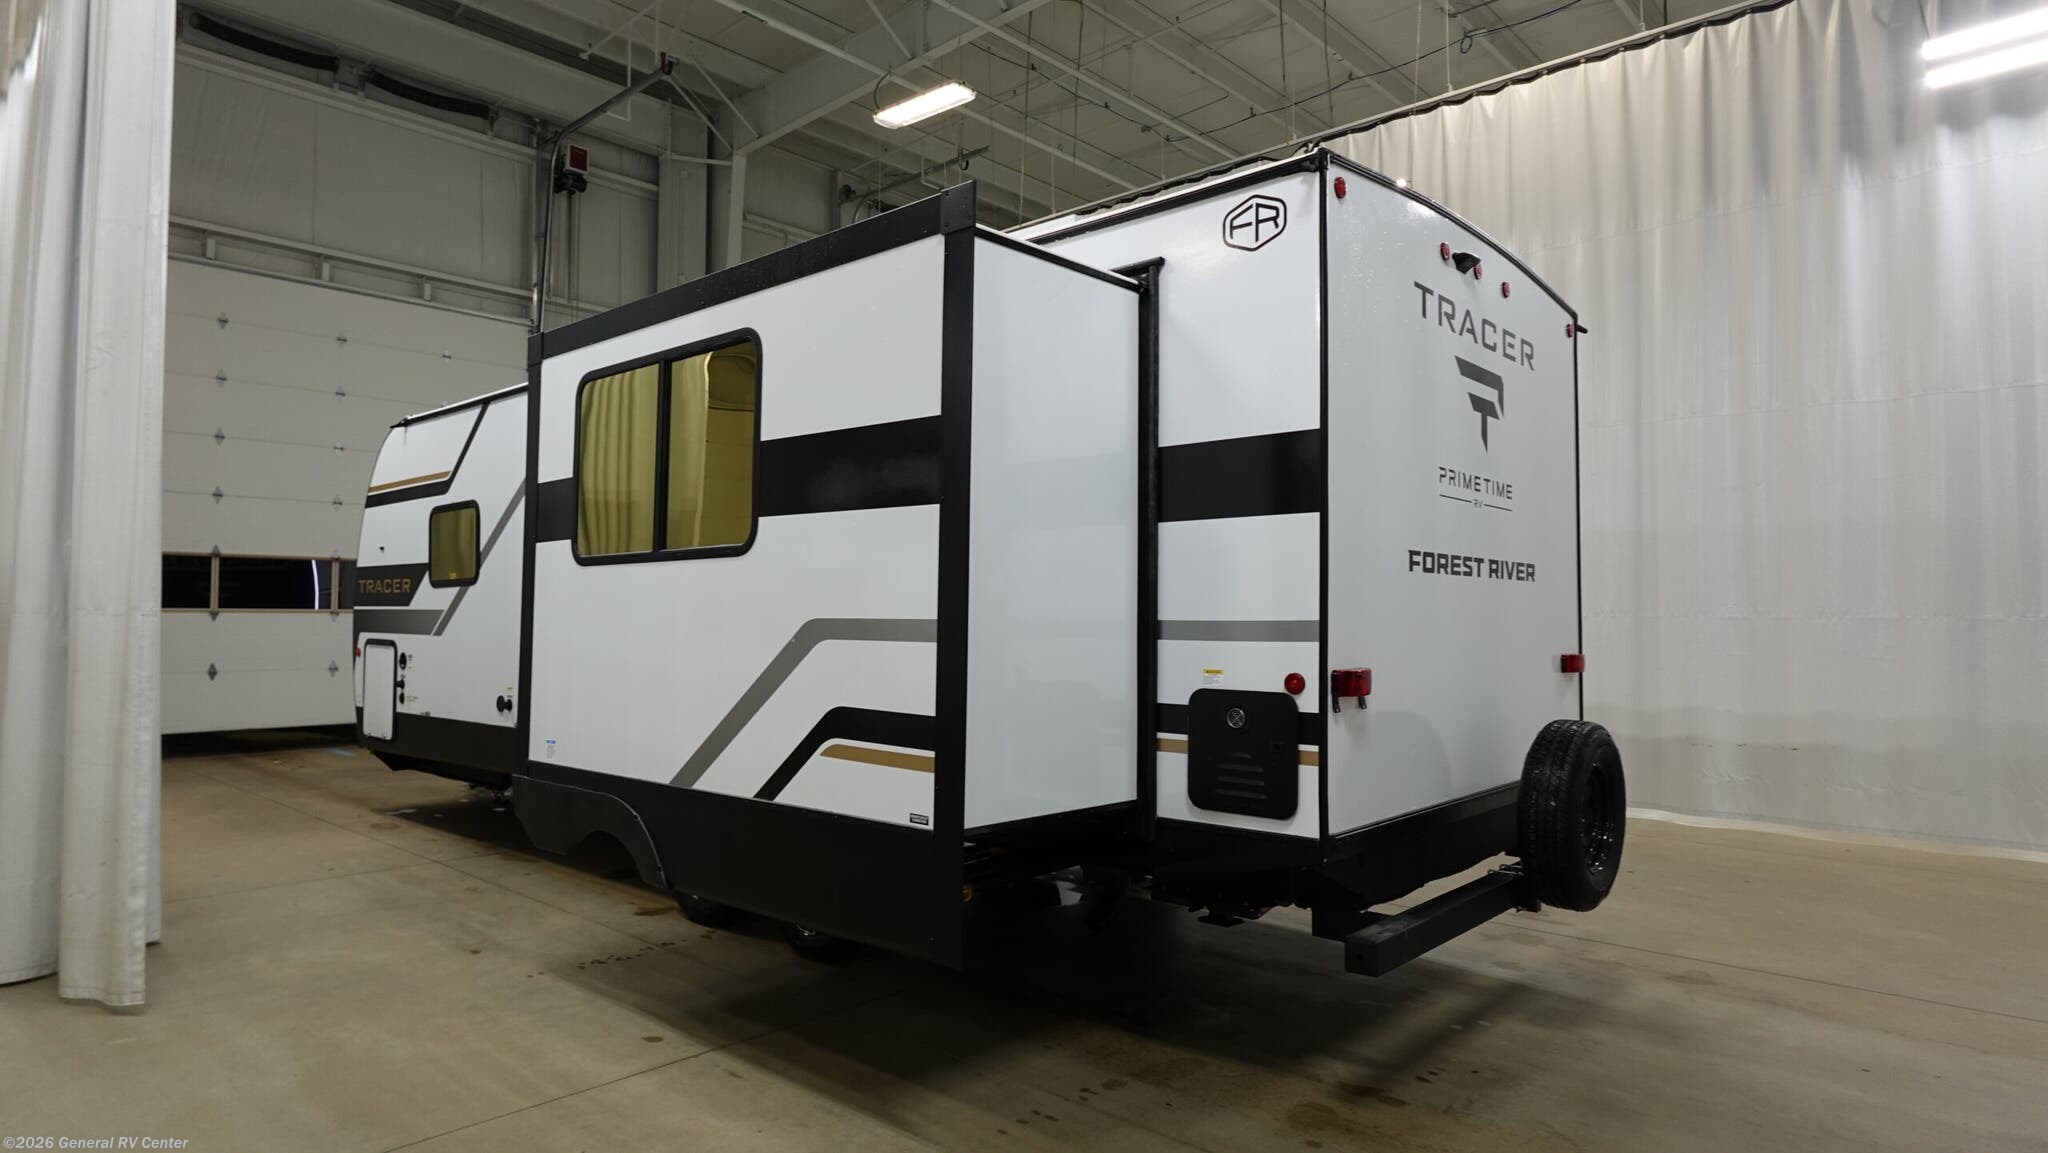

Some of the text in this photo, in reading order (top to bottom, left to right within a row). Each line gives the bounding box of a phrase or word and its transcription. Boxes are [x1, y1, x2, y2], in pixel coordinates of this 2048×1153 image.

[1413, 280, 1535, 371] TRACER
[1473, 499, 1483, 509] RV
[1408, 549, 1535, 582] FOREST RIVER
[358, 578, 411, 594] TRACER
